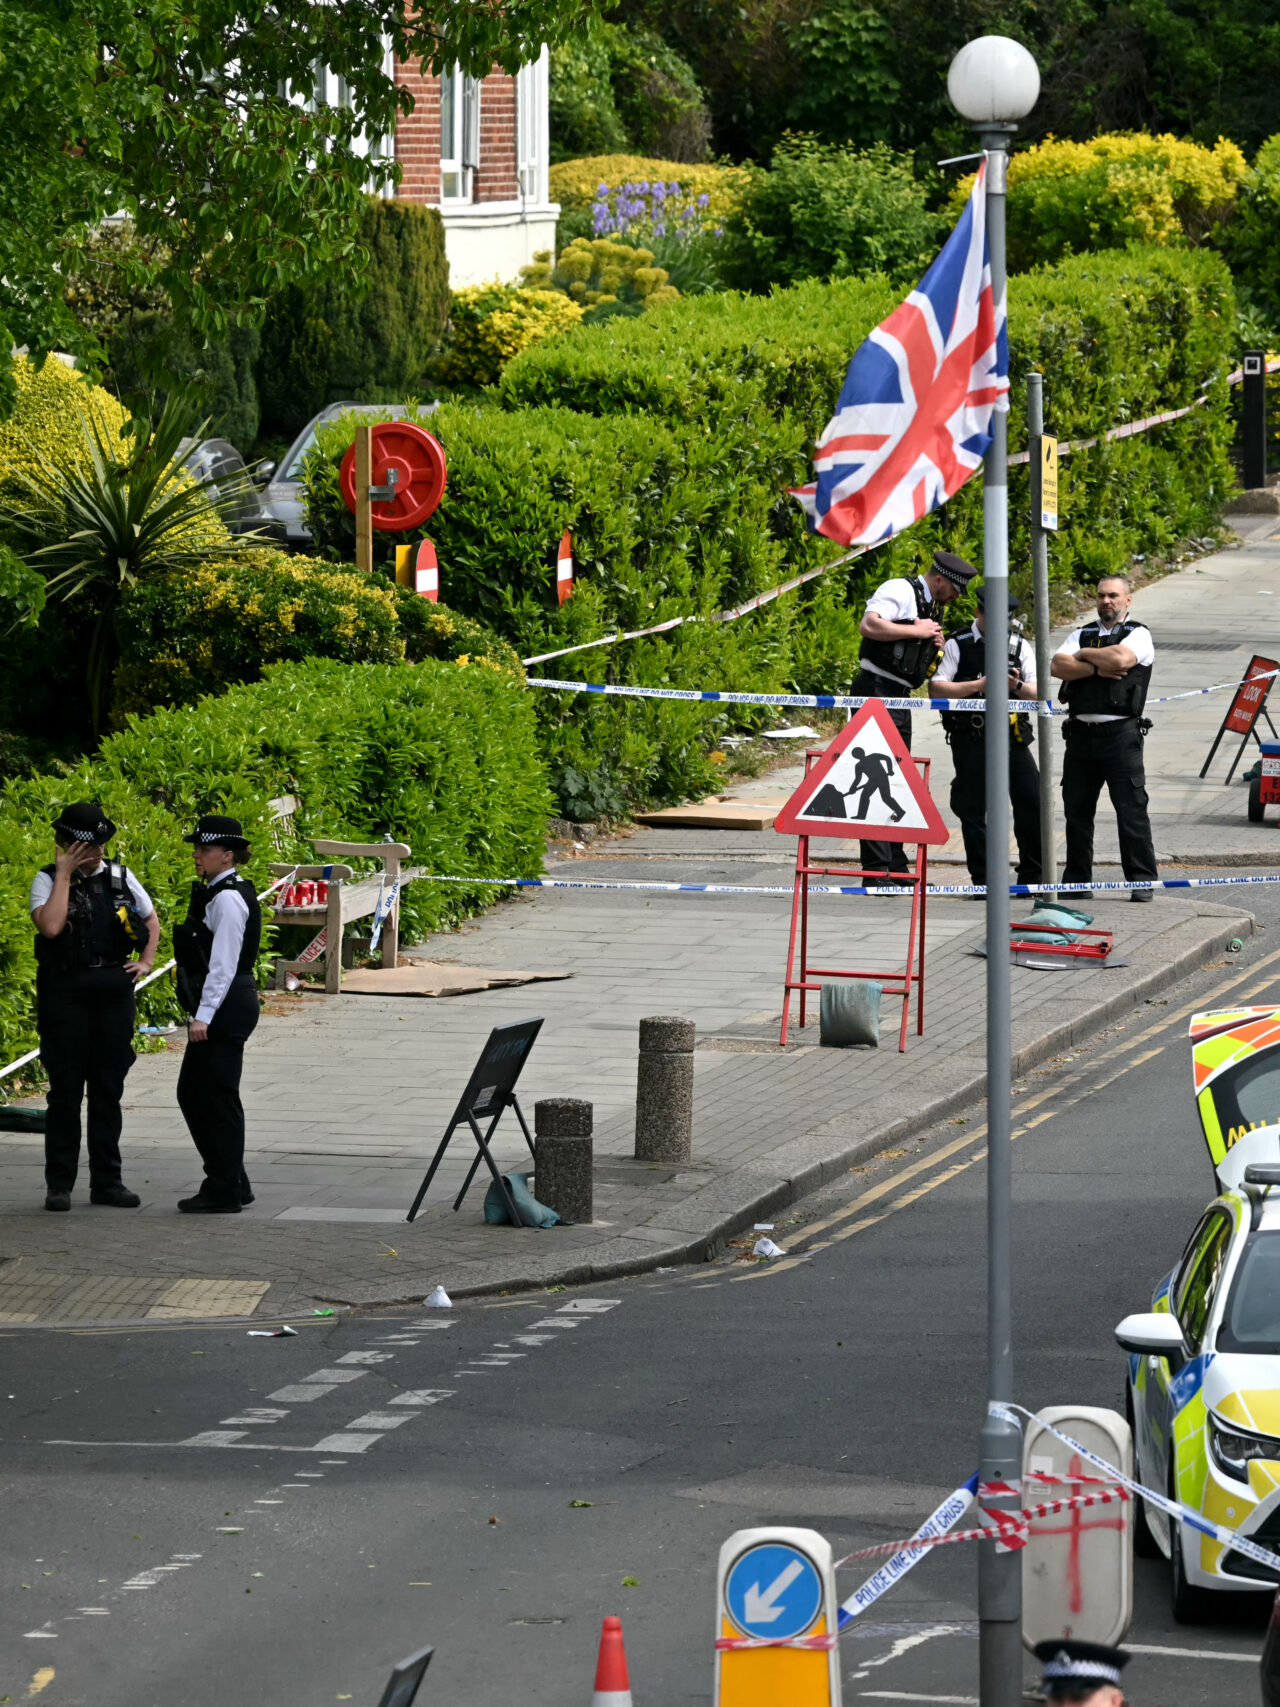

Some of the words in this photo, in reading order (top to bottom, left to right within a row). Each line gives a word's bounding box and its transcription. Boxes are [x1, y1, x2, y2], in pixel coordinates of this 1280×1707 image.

[1243, 684, 1262, 703] LOOK
[1017, 700, 1040, 711] CROSS
[854, 1571, 891, 1606] POLICE
[884, 1551, 911, 1579] LINE
[934, 1497, 966, 1529] CROSS
